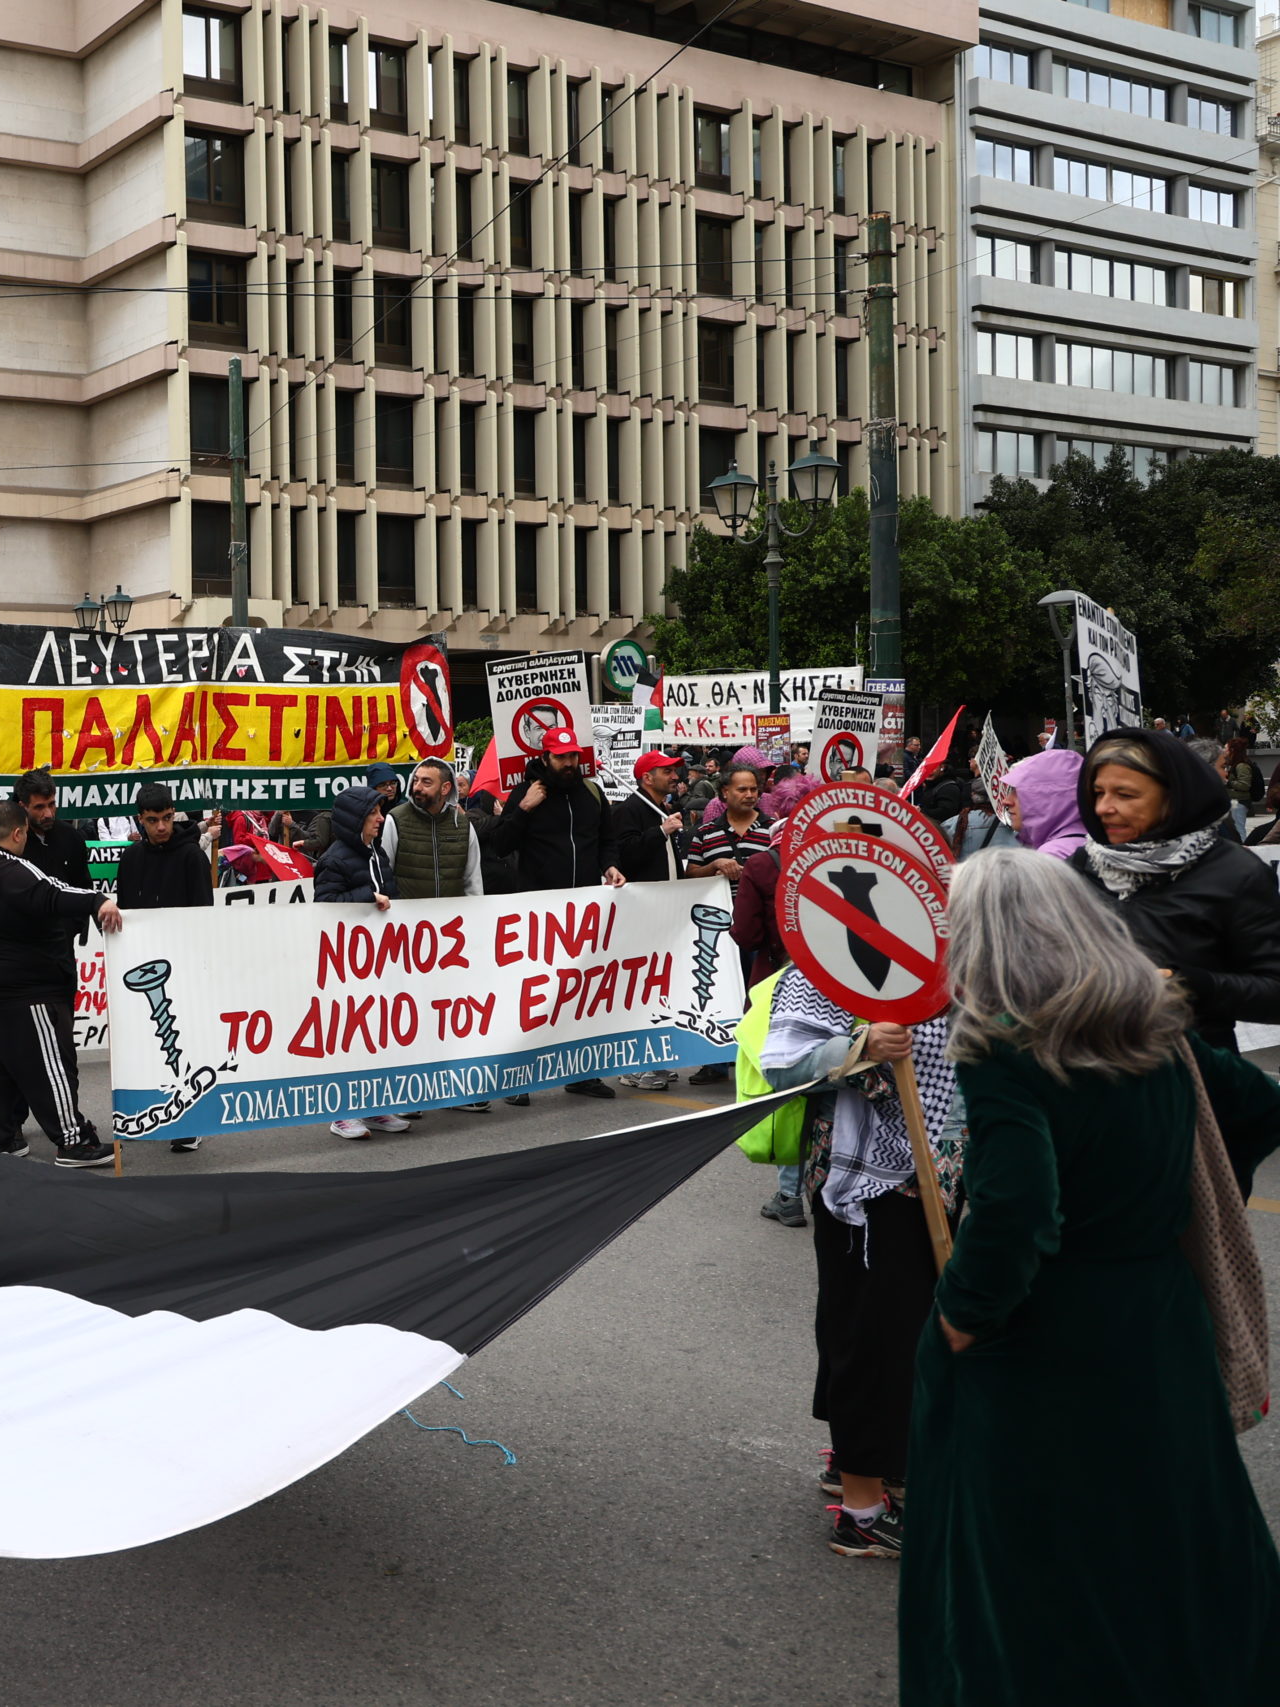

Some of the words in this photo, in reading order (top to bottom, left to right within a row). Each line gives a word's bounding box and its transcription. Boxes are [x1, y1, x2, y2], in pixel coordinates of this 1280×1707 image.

[27, 630, 266, 685] ΛΕΥΤΕΡΙΑ
[282, 645, 382, 683] ΣΤΗΝ
[497, 667, 577, 690] ΚΥΒΕΡΝΗΣΗ
[496, 680, 582, 703] ΔΟΛΟΦΟΝΩΝ
[663, 682, 698, 707] ΑΟΣ
[711, 681, 741, 706] ΘΑ
[753, 673, 842, 705] ΝΚΗΣΕΙ
[821, 704, 876, 721] ΚΥΒΕΡΝΗΣΗ
[20, 690, 397, 771] ΠΑΛΑΙΣΤΙΝΗ
[817, 717, 877, 733] ΔΟΛΟΦΟΝΩΝ
[794, 788, 876, 831] ΣΤΑΜΑΤΗΣΤΕ
[879, 795, 912, 823] ΤΟΝ
[787, 838, 868, 883] ΣΤΑΜΑΤΗΣΤΕ
[872, 845, 907, 875] ΤΟΝ
[783, 880, 798, 933] Συμμαχία
[904, 870, 952, 939] ΠΟΛΕΜΟ
[317, 915, 469, 990] ΝΟΜΟΣ
[495, 901, 616, 967] ΕΙΝΑΙ
[220, 1010, 273, 1055] ΤΟ
[287, 992, 419, 1058] ΔΙΚΙΟ
[431, 992, 496, 1041] ΤΟΥ
[520, 952, 673, 1033] ΕΡΓΑΤΗ
[220, 1081, 341, 1126] ΣΩΜΑΤΕΙΟ
[347, 1064, 500, 1112] ΕΡΓΑΖΟΜΕΝΩΝ
[502, 1063, 534, 1090] ΣΤΗΝ
[536, 1038, 640, 1083] ΤΣΑΜΟΥΡΗΣ
[642, 1034, 680, 1064] Α.Ε.
